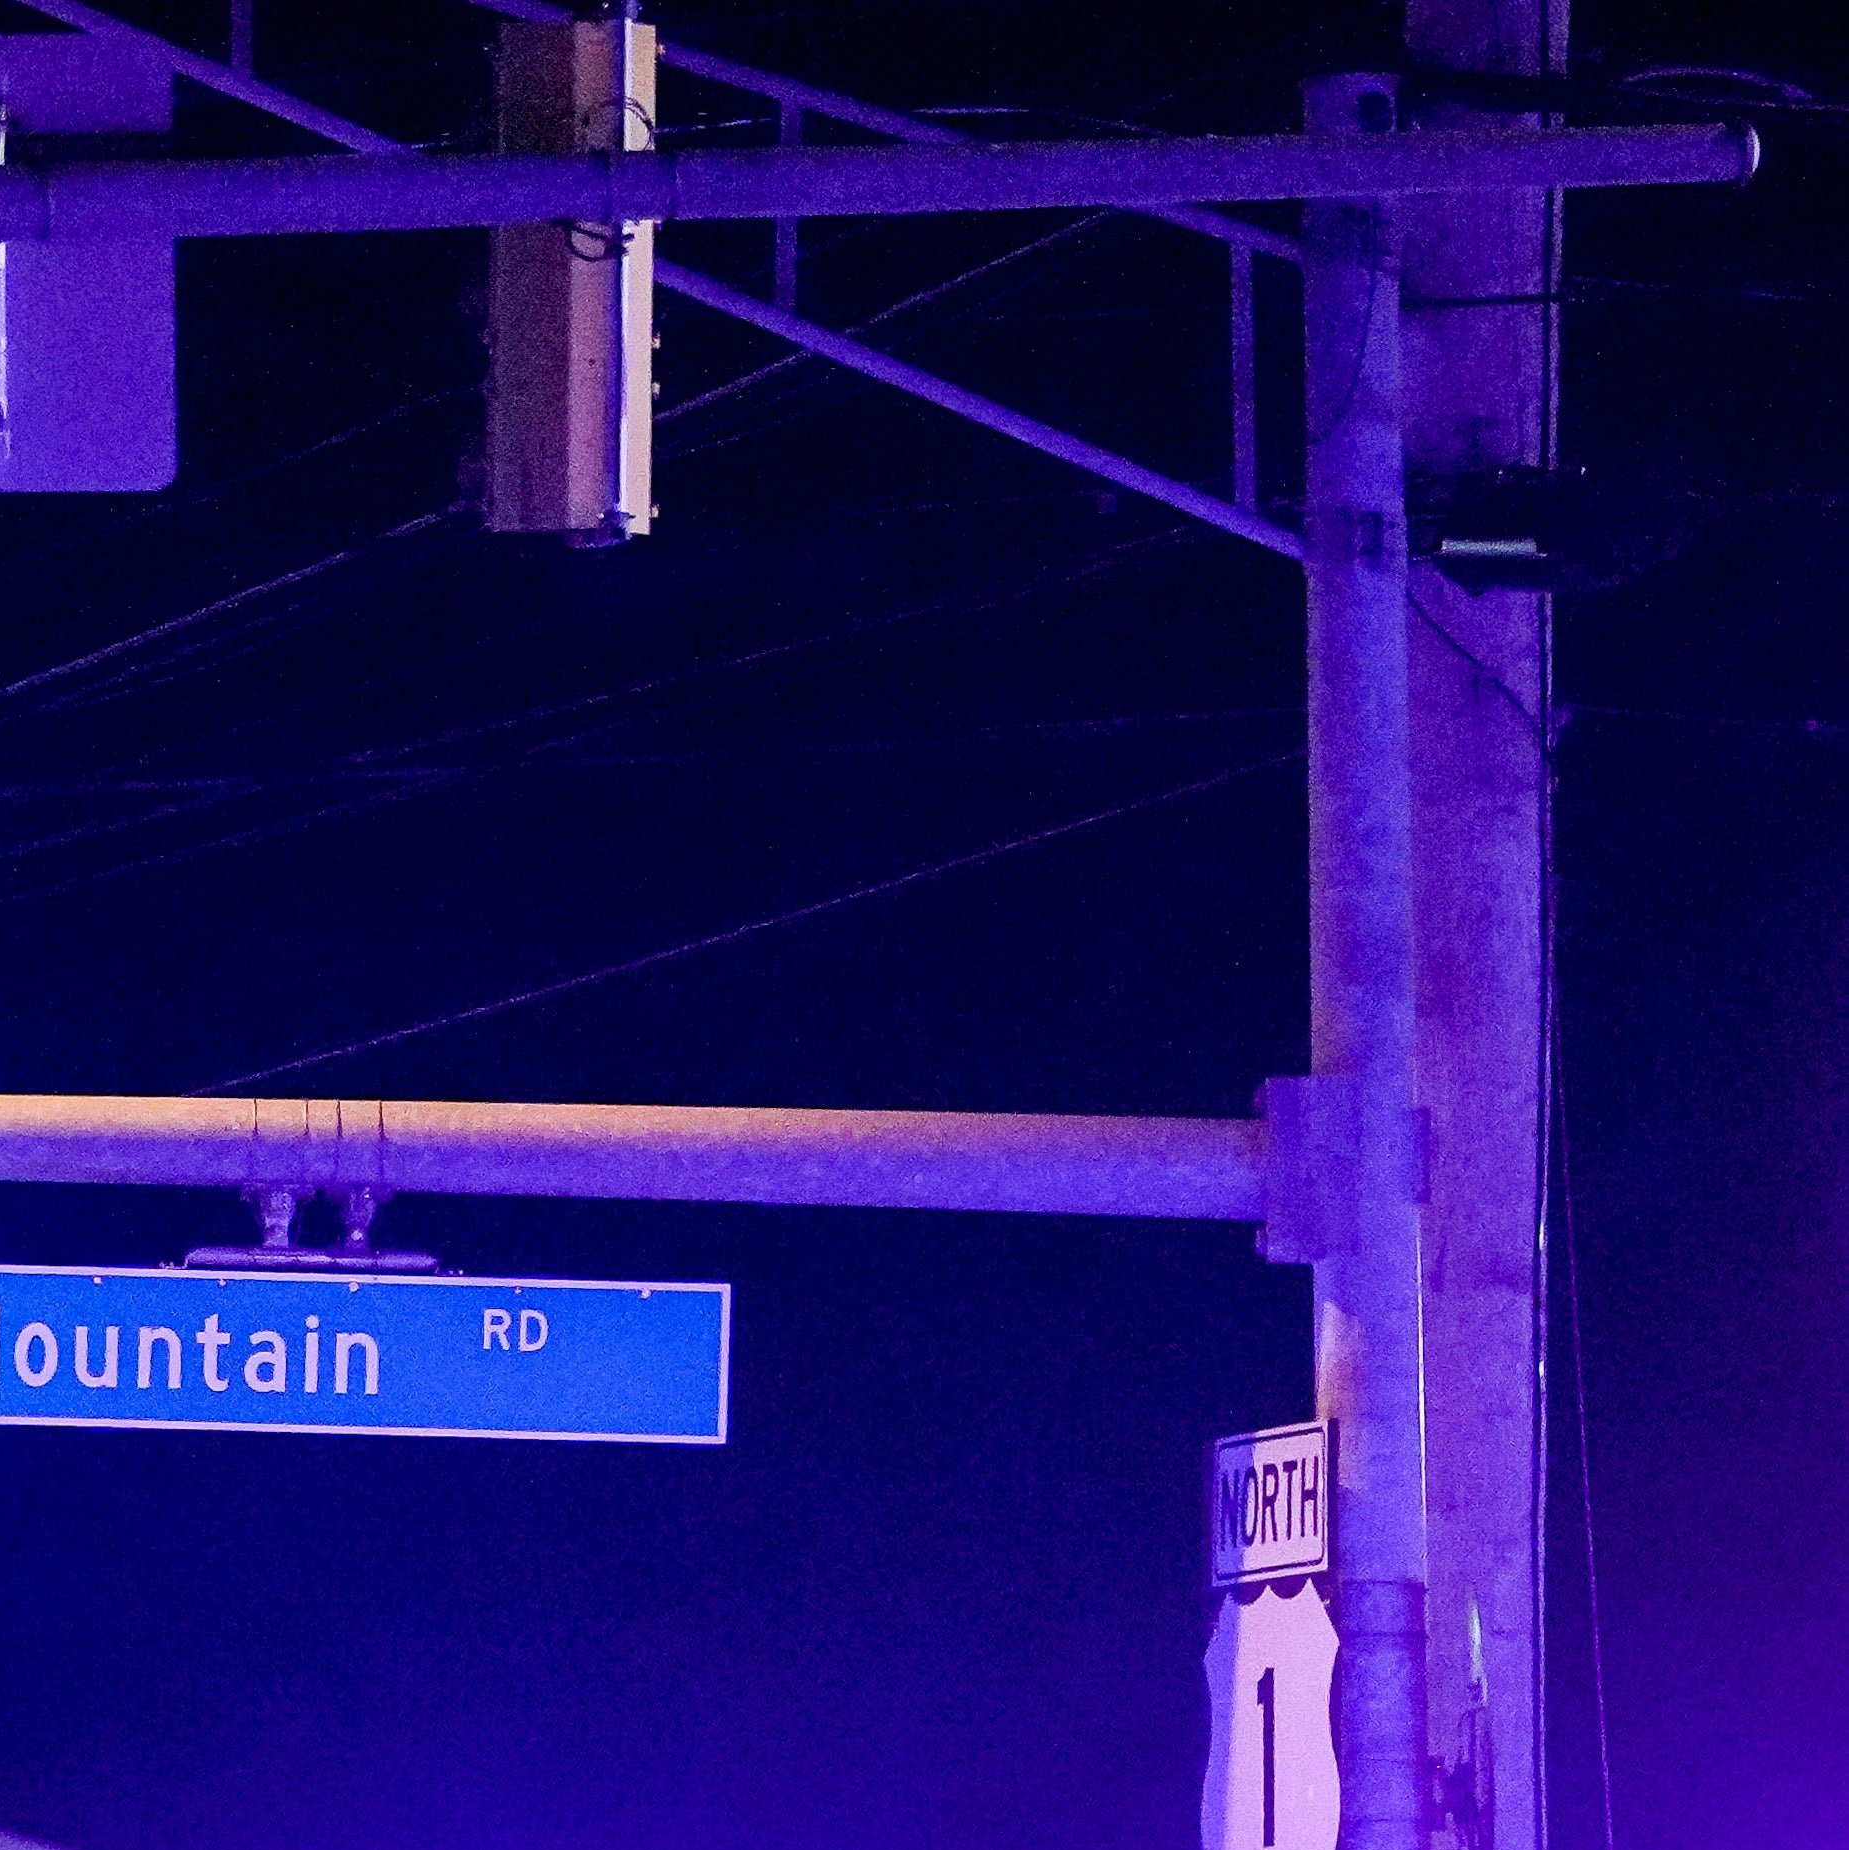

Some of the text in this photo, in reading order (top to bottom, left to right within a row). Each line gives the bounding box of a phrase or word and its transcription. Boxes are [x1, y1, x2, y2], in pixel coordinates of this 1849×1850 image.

[483, 1308, 549, 1353] RD
[1219, 1455, 1320, 1549] NORTH
[1256, 1667, 1275, 1848] 1
